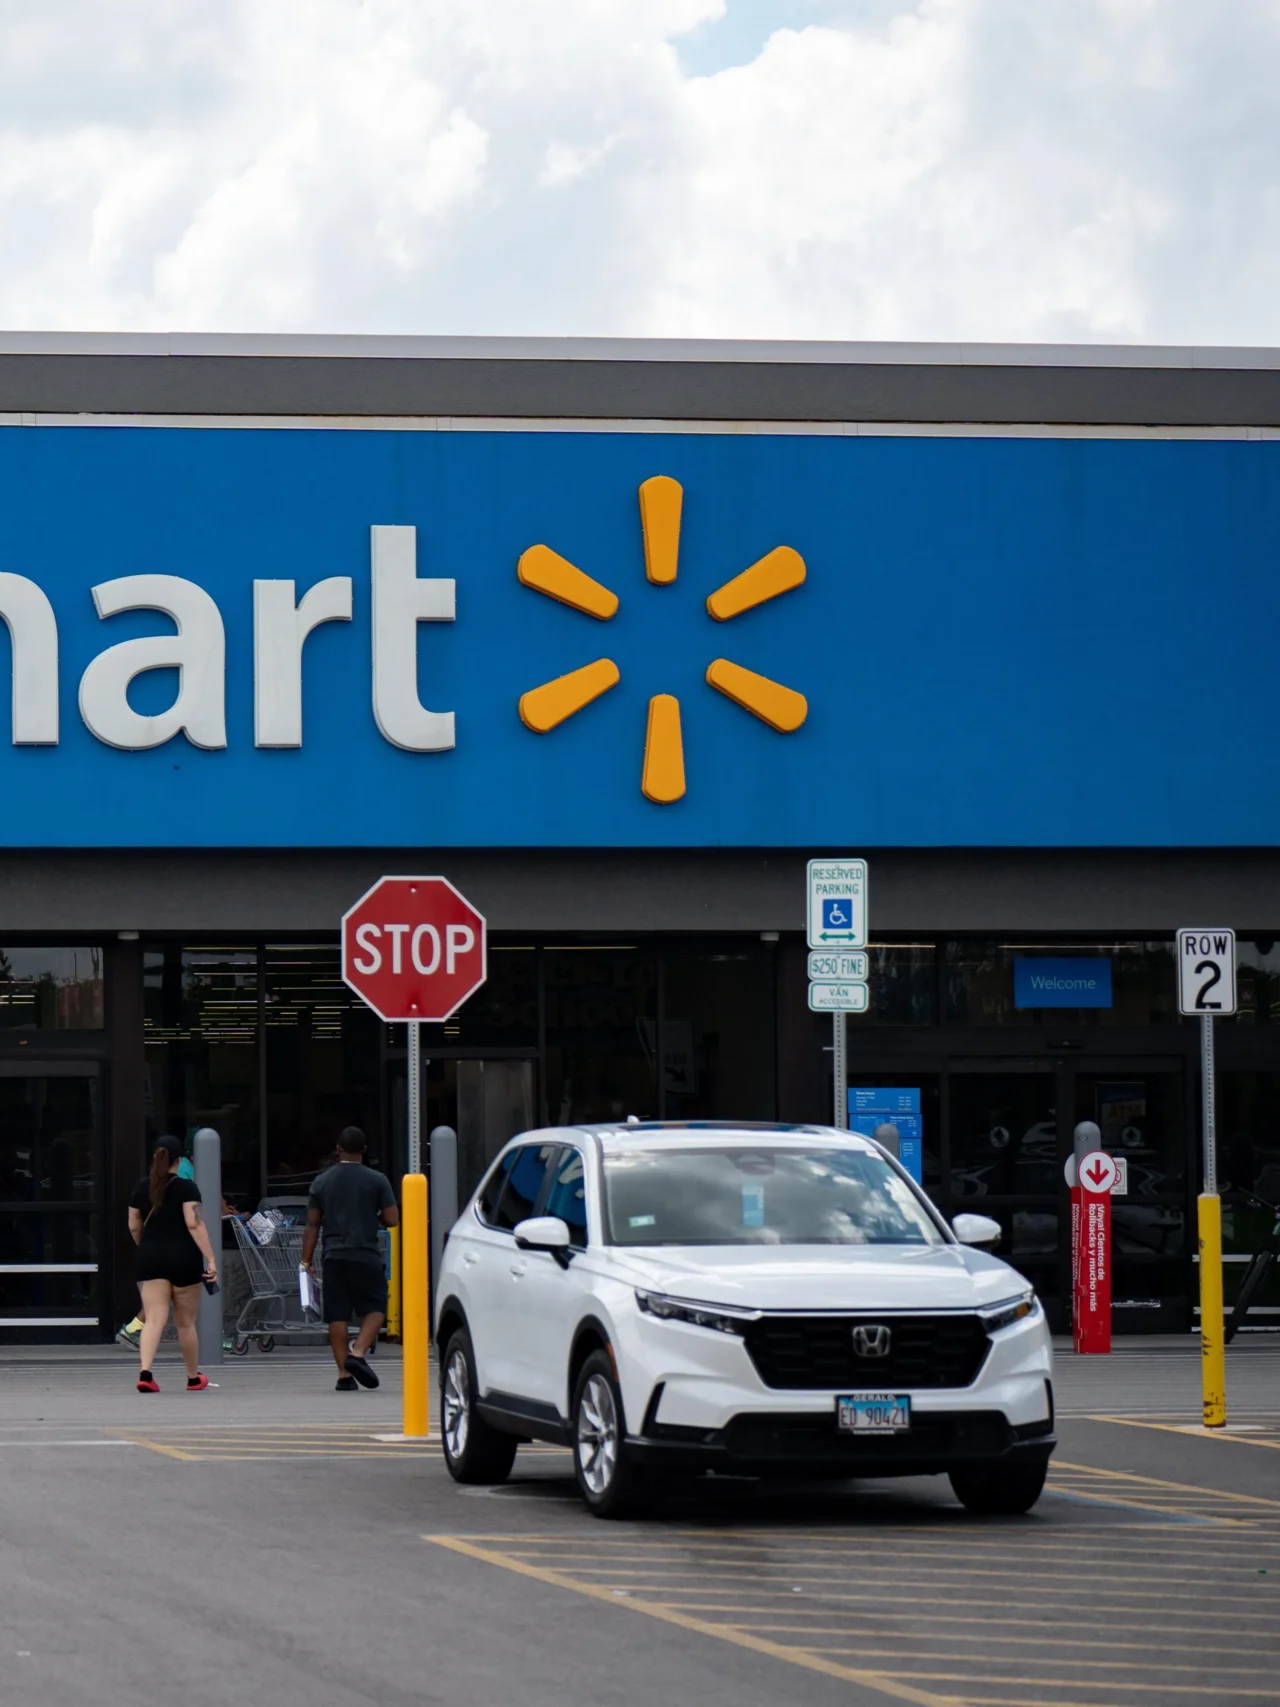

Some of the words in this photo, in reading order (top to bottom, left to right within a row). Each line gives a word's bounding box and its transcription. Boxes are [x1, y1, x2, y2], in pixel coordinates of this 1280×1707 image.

[812, 868, 863, 880] RESERVED
[816, 884, 859, 895] PARKING
[353, 922, 476, 976] STOP
[1185, 935, 1227, 955] ROW
[812, 958, 838, 975] $250
[841, 958, 863, 975] FINE
[1030, 975, 1097, 990] Welcome
[1194, 959, 1222, 1010] 2
[829, 988, 850, 998] VAN
[1089, 1203, 1097, 1248] Rollbacks
[1097, 1232, 1105, 1267] Cientos
[1089, 1257, 1097, 1290] mucho
[1098, 1268, 1105, 1280] de
[840, 1407, 858, 1426] ED
[865, 1406, 909, 1426] 90421
